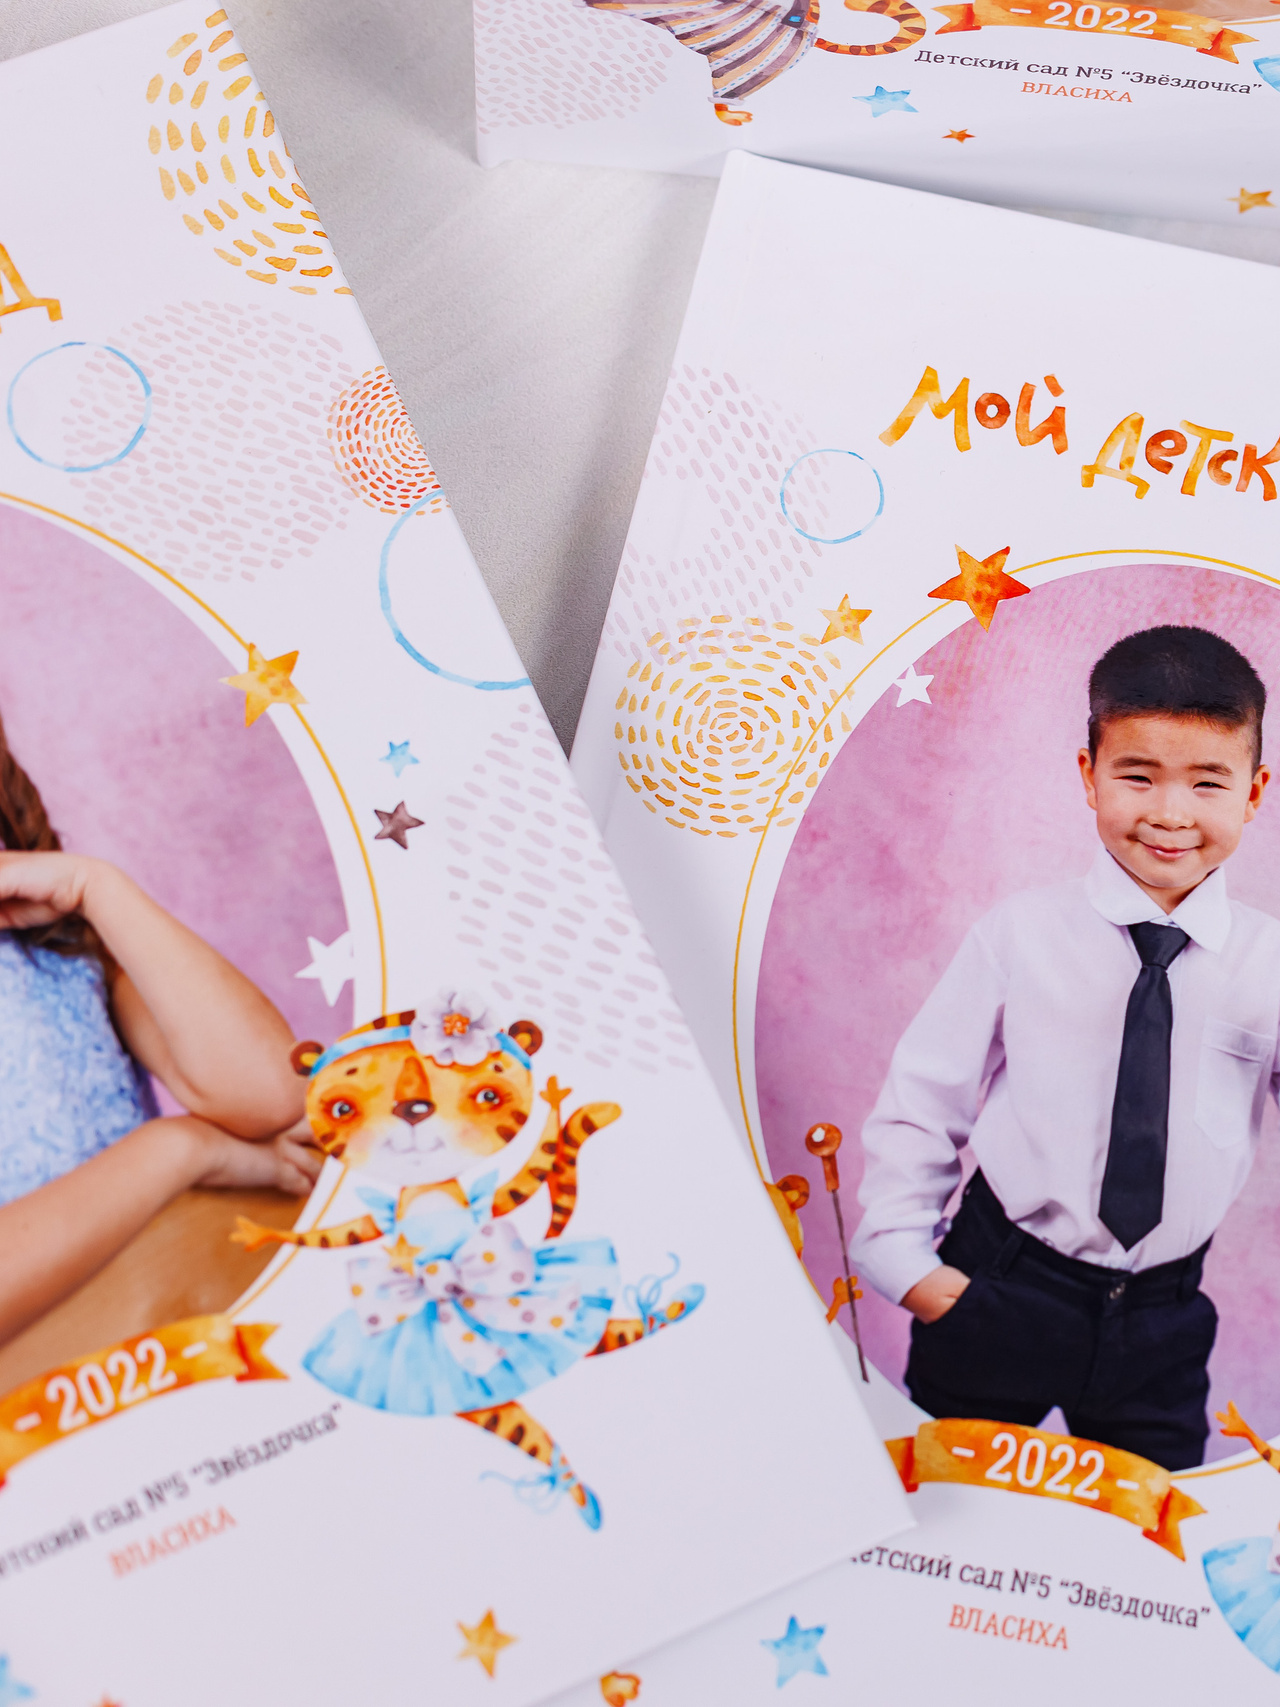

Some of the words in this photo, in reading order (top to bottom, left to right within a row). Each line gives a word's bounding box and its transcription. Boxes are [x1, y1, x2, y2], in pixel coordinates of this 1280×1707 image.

[1043, 1, 1159, 35] 2022
[914, 50, 1020, 72] Детский
[1026, 61, 1068, 77] сад
[1021, 81, 1133, 103] ВЛАСИХА
[45, 1337, 178, 1432] 2022
[985, 1432, 1105, 1500] 2022
[93, 1498, 145, 1533] сад
[108, 1505, 238, 1579] ВЛАСИХА
[959, 1563, 1002, 1593] сад
[948, 1605, 1069, 1650] ВЛАСИХА
